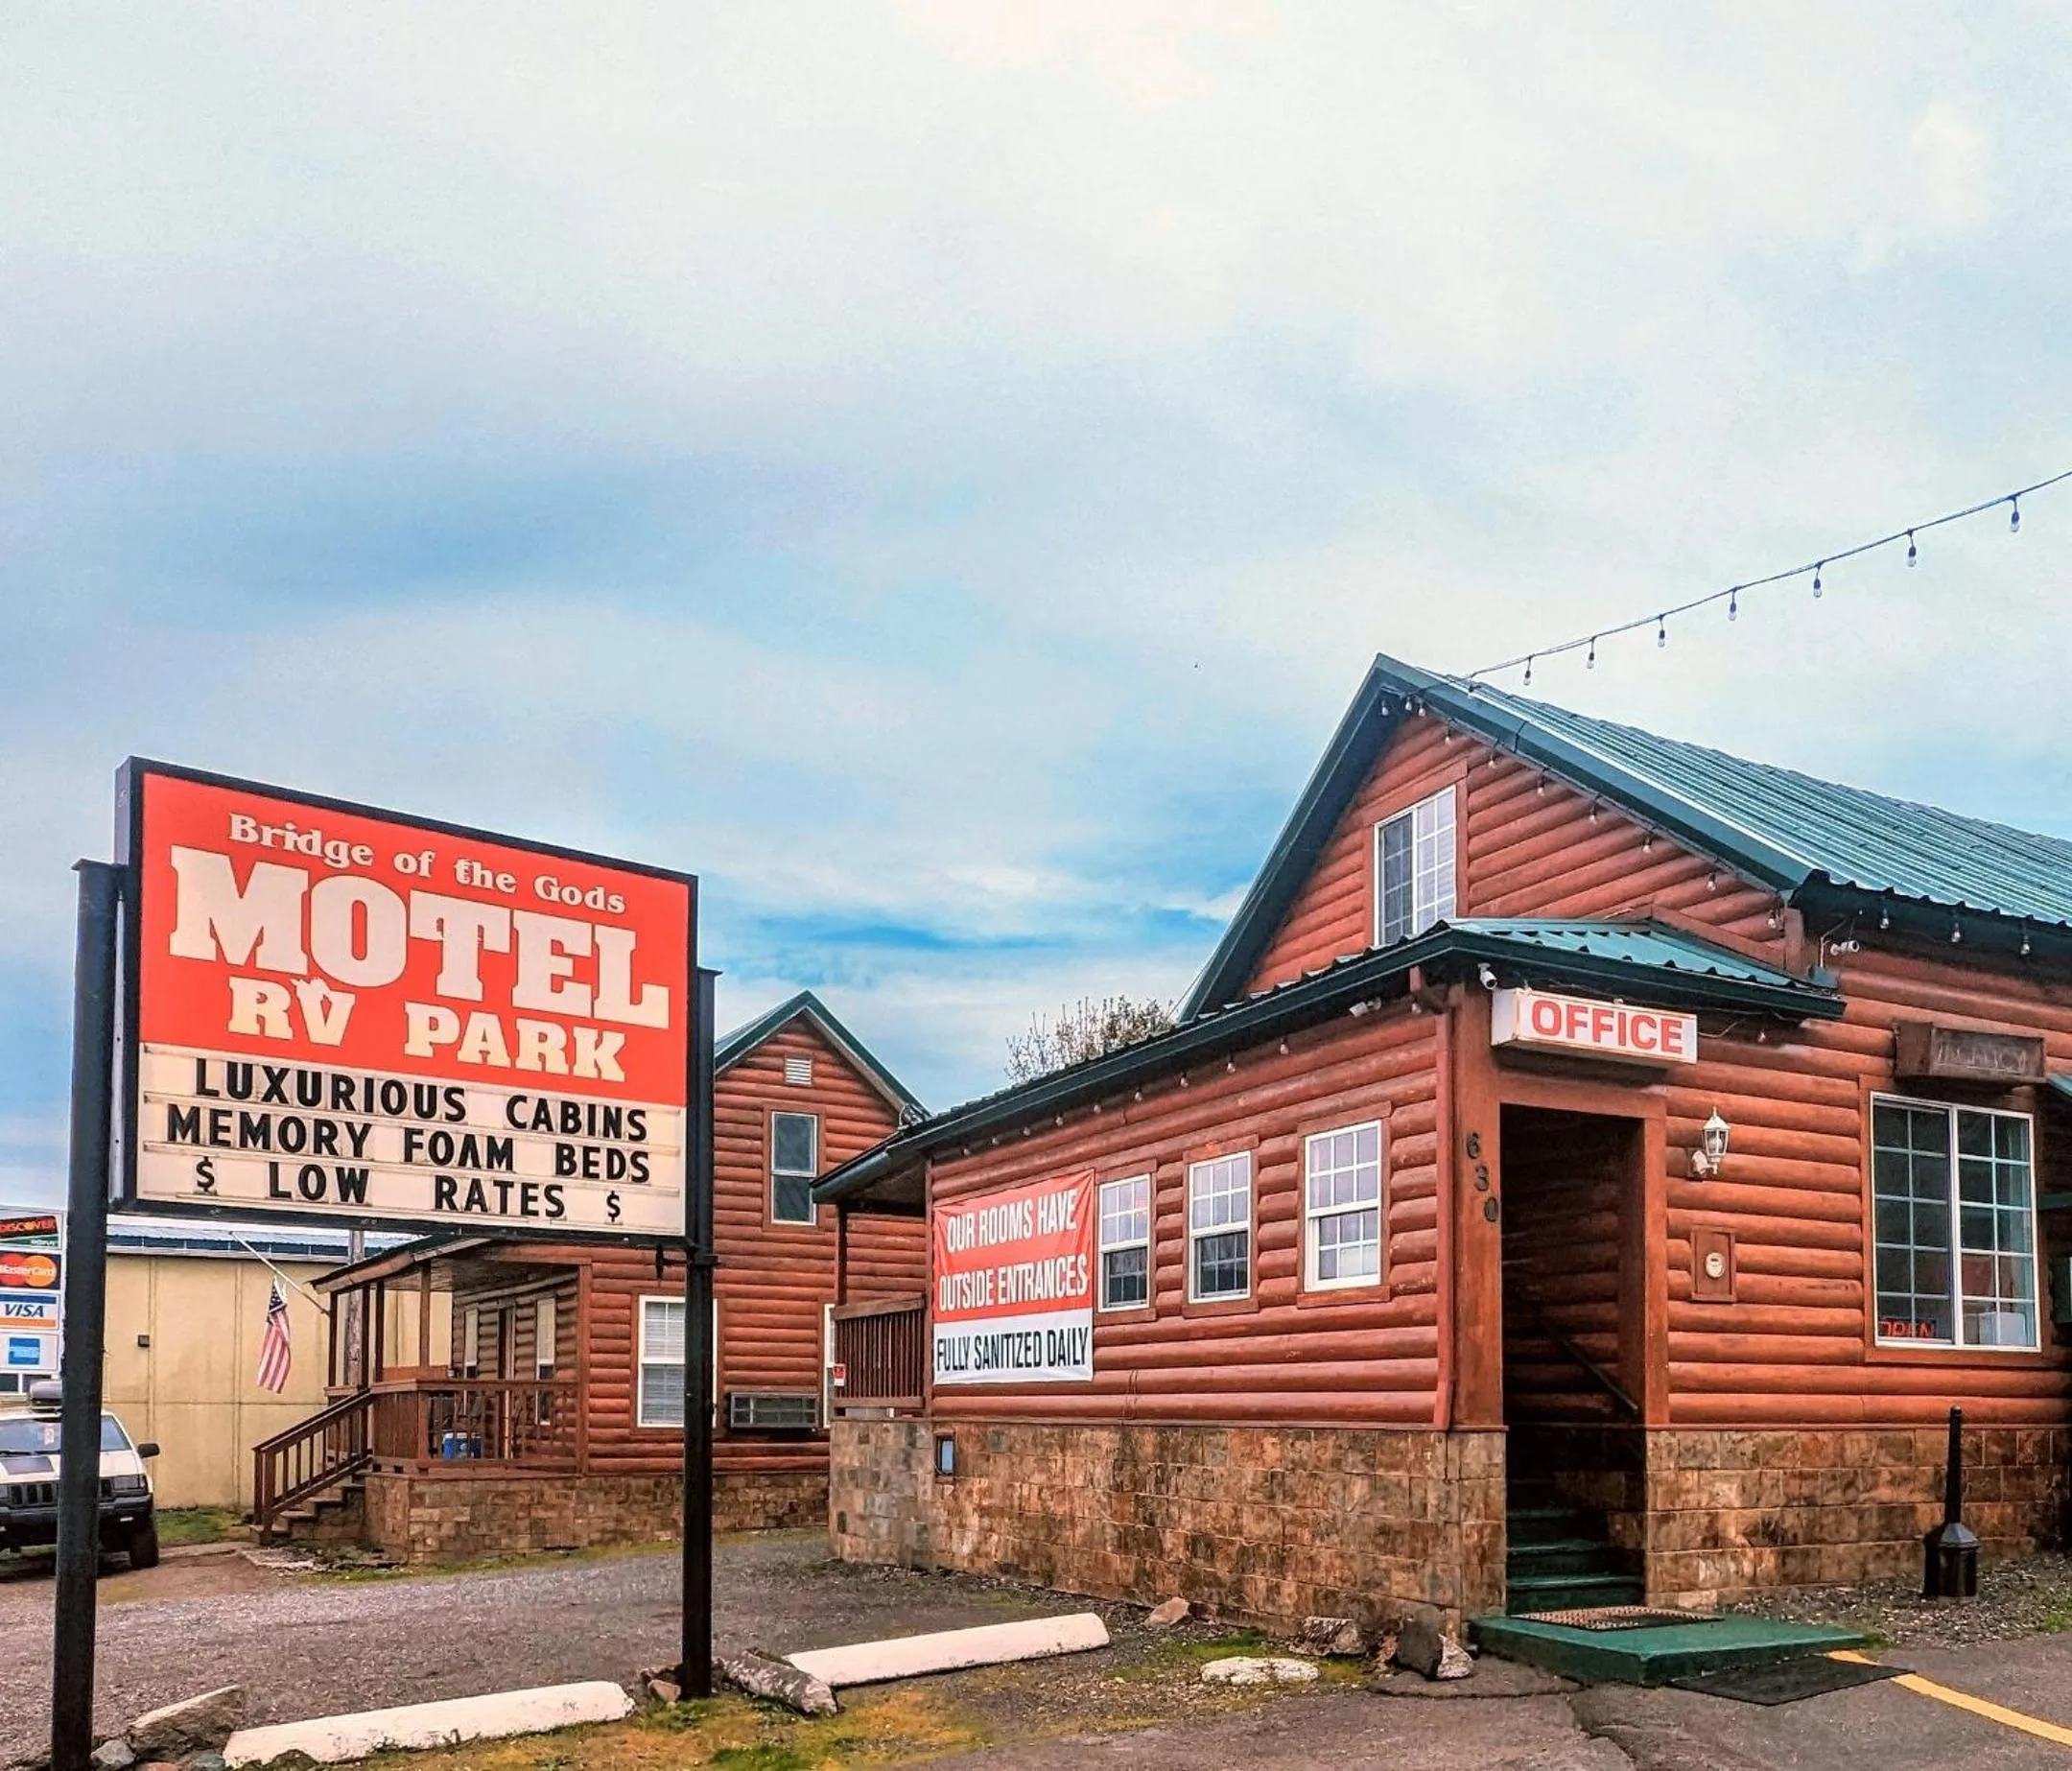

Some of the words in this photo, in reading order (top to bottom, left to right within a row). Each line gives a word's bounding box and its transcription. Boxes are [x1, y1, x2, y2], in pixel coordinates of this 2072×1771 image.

[229, 813, 374, 868] Bridge
[393, 850, 436, 878] of
[454, 859, 517, 893] the
[533, 875, 626, 914] Gods
[169, 844, 670, 1029] MOTEL
[227, 976, 357, 1047] RV
[403, 1001, 625, 1082] PARK
[1532, 1000, 1683, 1053] OFFICE
[196, 1058, 466, 1122] LUXURIOUS
[506, 1095, 648, 1142] CABINS
[167, 1103, 372, 1158] MEMORY
[404, 1126, 514, 1171] FOAM
[555, 1142, 650, 1183] BEDS
[1466, 1132, 1498, 1222] 630
[196, 1156, 216, 1192] $
[269, 1161, 369, 1204] LOW
[435, 1174, 566, 1218] RATES
[606, 1191, 622, 1222] $
[947, 1212, 976, 1254] OUR
[978, 1198, 1032, 1248] ROOMS
[1037, 1189, 1077, 1236] HAVE
[5, 1304, 44, 1317] VISA
[939, 1268, 994, 1311] OUTSIDE
[998, 1253, 1088, 1300] ENTRANCES
[937, 1336, 971, 1371] FULLY
[975, 1331, 1043, 1371] SANITIZED
[1048, 1327, 1089, 1366] DAILY
